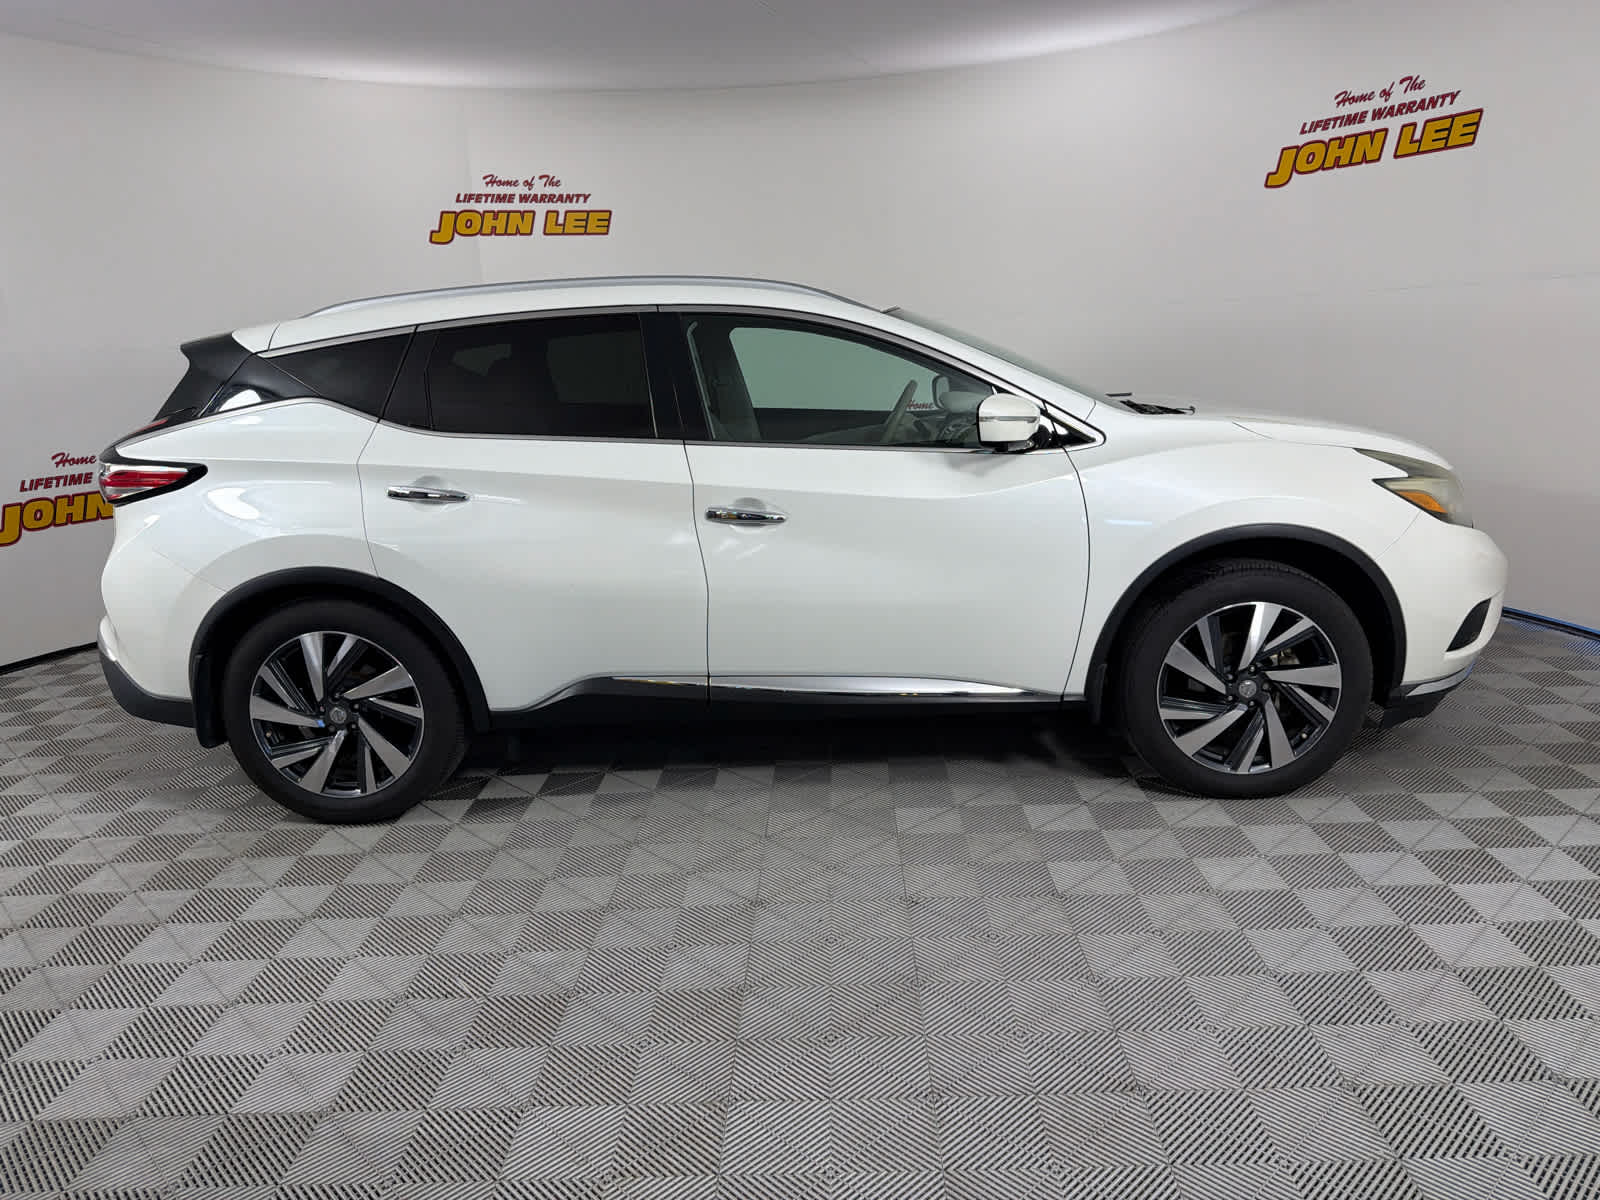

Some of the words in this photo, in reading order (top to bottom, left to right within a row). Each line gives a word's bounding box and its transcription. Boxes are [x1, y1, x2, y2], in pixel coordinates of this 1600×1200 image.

[1334, 90, 1375, 108] Home
[1379, 82, 1395, 102] of
[1399, 75, 1426, 94] The
[1300, 110, 1368, 135] LIFETIME
[1371, 90, 1461, 121] WARRANTY
[1264, 128, 1389, 189] JOHN
[1393, 108, 1484, 159] LEE
[482, 174, 520, 187] Home
[523, 176, 535, 190] of
[539, 174, 561, 187] The
[455, 193, 515, 203] LIFETIME
[518, 193, 591, 203] WARRANTY
[429, 209, 536, 245] JOHN
[543, 210, 612, 236] LEE
[51, 452, 97, 468] Home
[19, 472, 93, 492] LIFETIME
